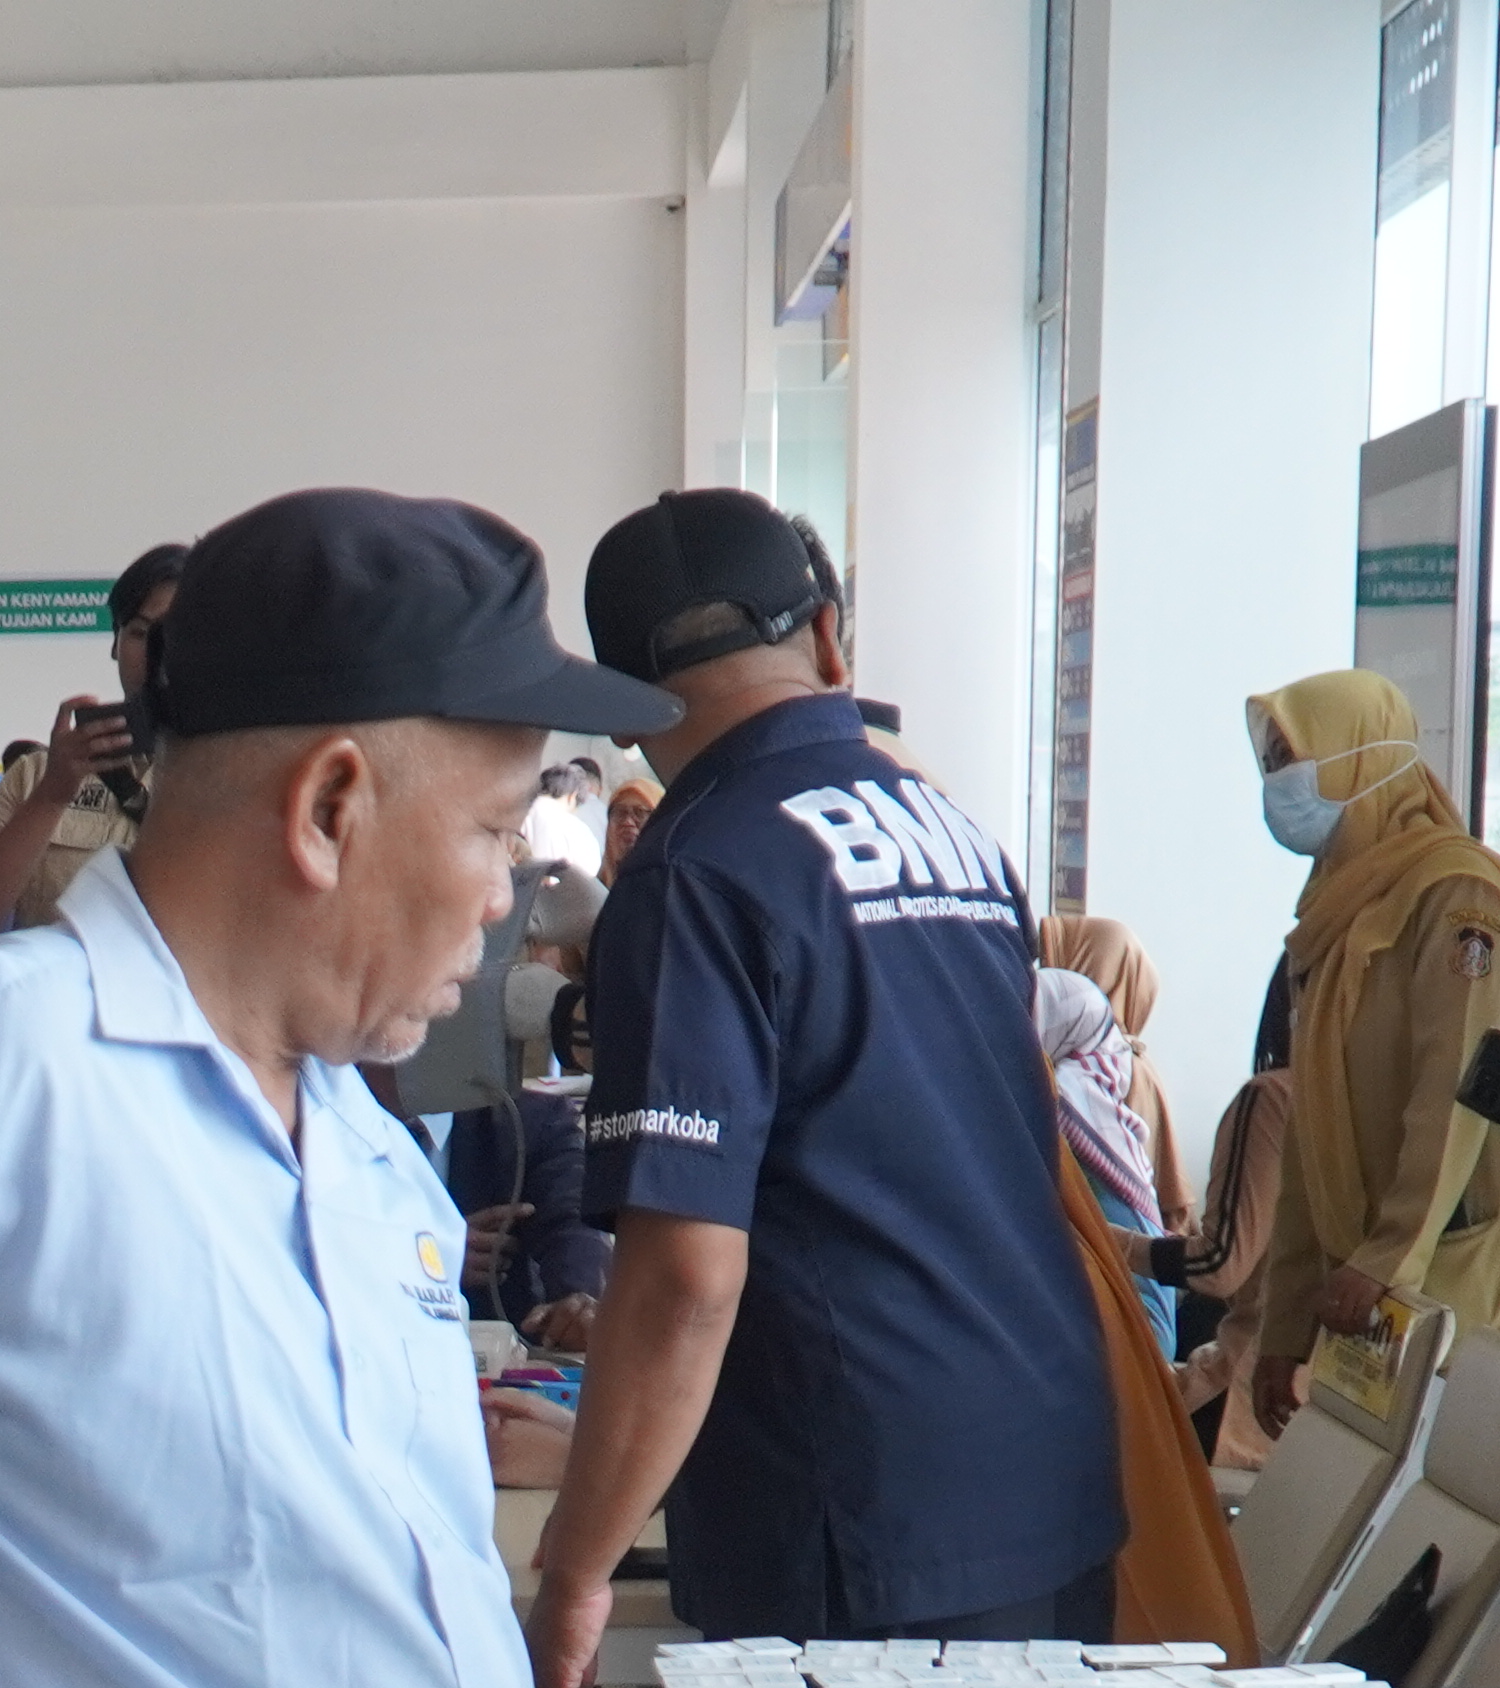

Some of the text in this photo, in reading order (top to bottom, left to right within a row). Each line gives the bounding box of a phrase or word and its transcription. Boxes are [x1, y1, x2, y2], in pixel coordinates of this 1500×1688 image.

[56, 611, 98, 627] KAMI
[780, 778, 1013, 898] BNN
[589, 1105, 720, 1145] #stopnarkoba
